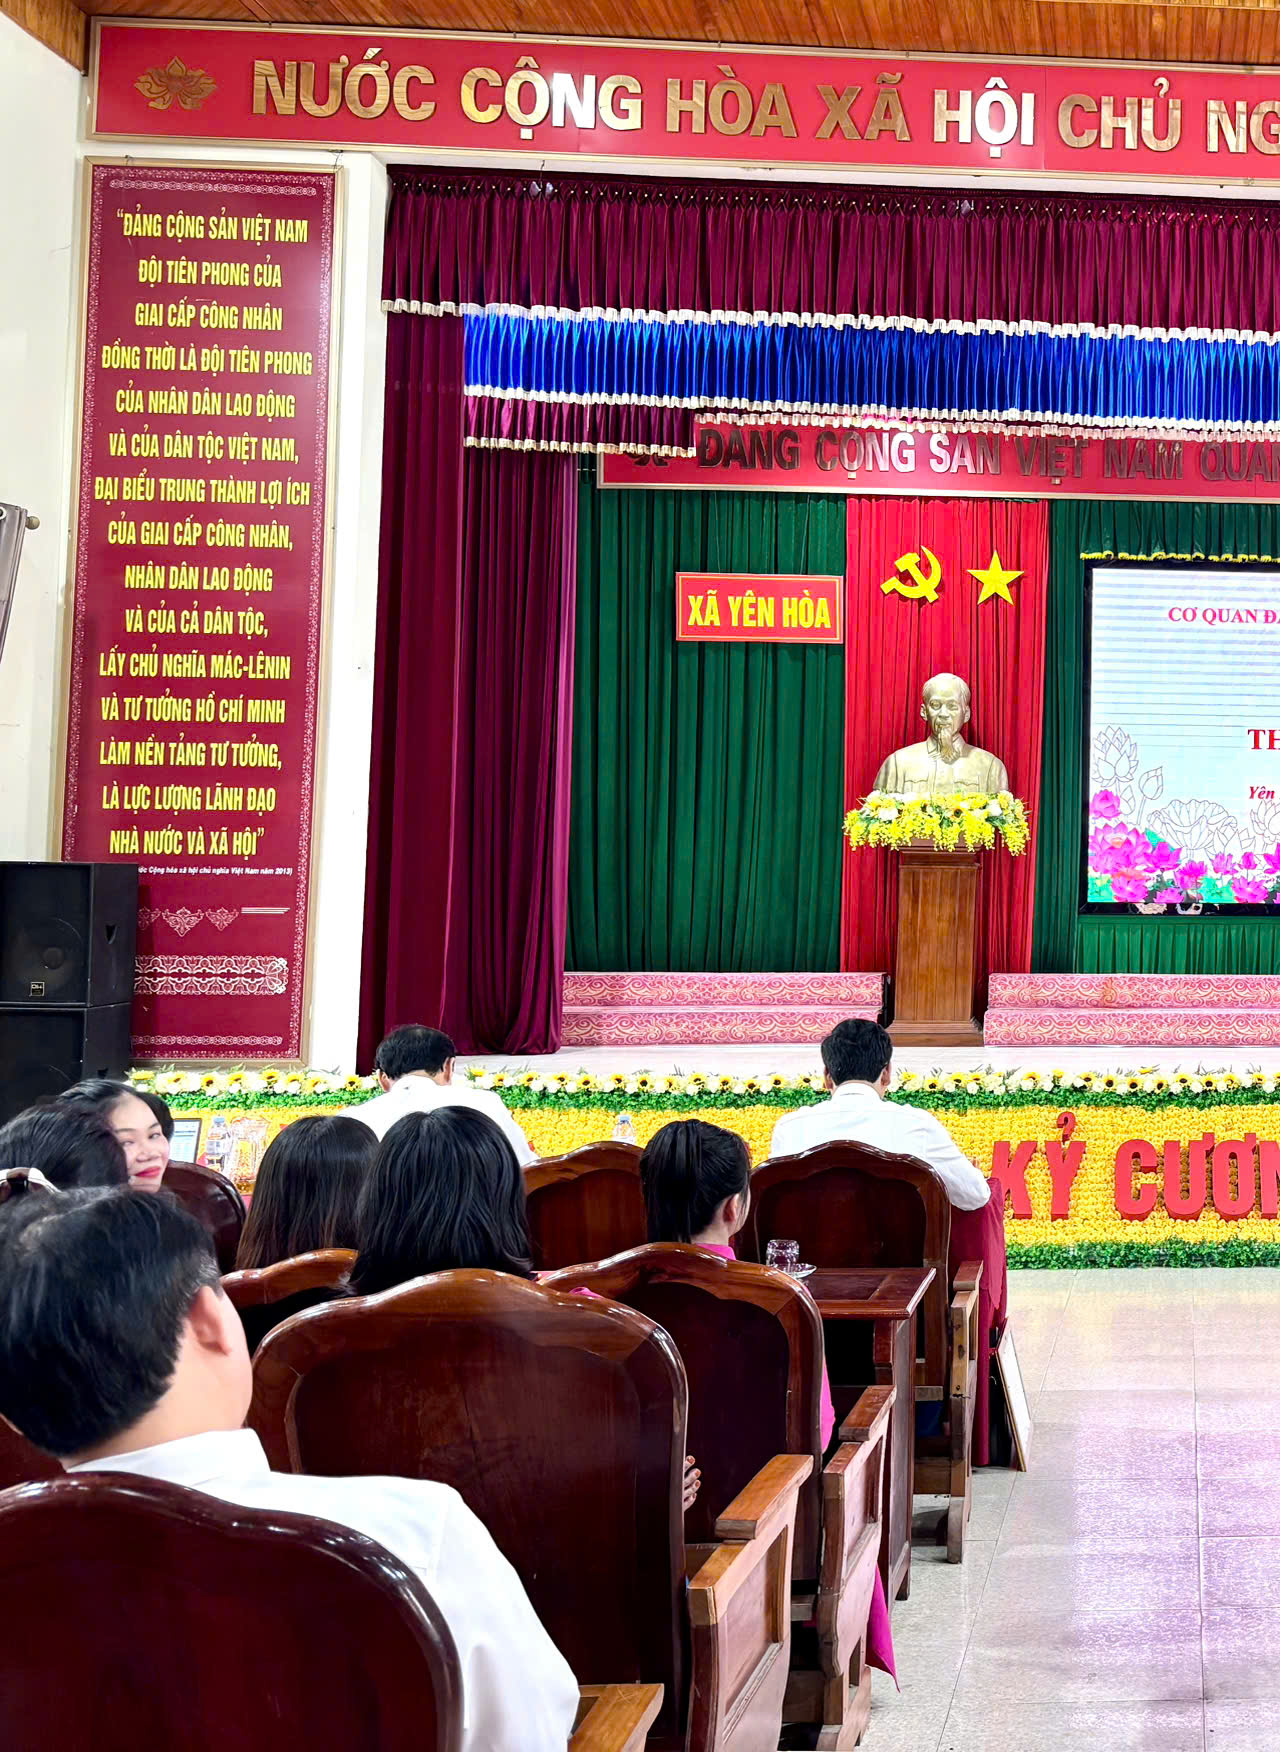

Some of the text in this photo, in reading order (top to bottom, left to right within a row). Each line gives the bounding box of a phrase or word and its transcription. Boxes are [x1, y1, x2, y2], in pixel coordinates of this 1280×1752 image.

[252, 48, 435, 121] NƯỚC
[460, 56, 642, 140] CỘNG
[667, 64, 797, 138] HÒA
[815, 72, 910, 142] XÃ
[933, 77, 1035, 158] HỘI
[1058, 77, 1181, 151] CHỦ
[167, 210, 204, 242] CỘNG
[209, 207, 237, 239] SẢN
[242, 213, 271, 246] VIỆT
[275, 219, 308, 242] NAM
[139, 254, 281, 287] ĐỘI TIÊN PHONG CỦA
[136, 296, 282, 330] GIAI CẤP CÔNG NHÂN
[116, 380, 295, 422] CỦA NHÂN DÂN LAO ĐỘNG
[1104, 440, 1183, 479] NAM
[95, 468, 310, 509] ĐẠI BIỂU TRUNG THÀNH LỢI ÍCH
[125, 561, 272, 596] NHÂN DÂN LAO ĐỘNG
[687, 589, 831, 628] XÃ YÊN HÒA
[1168, 606, 1198, 622] CƠ
[1202, 608, 1258, 625] QUAN
[100, 644, 290, 679] LẤY CHỦ NGHĨA MÁC-LÊNIN
[100, 737, 130, 764] LÀM
[135, 734, 164, 765] NỀN
[170, 732, 206, 766] TẢNG
[210, 741, 229, 766] TƯ
[1249, 786, 1275, 800] Yên
[110, 826, 138, 853] NHÀ
[144, 824, 182, 854] NƯỚC
[188, 826, 204, 854] VÀ
[209, 827, 228, 854] XÃ
[992, 1111, 1086, 1221] KỶ
